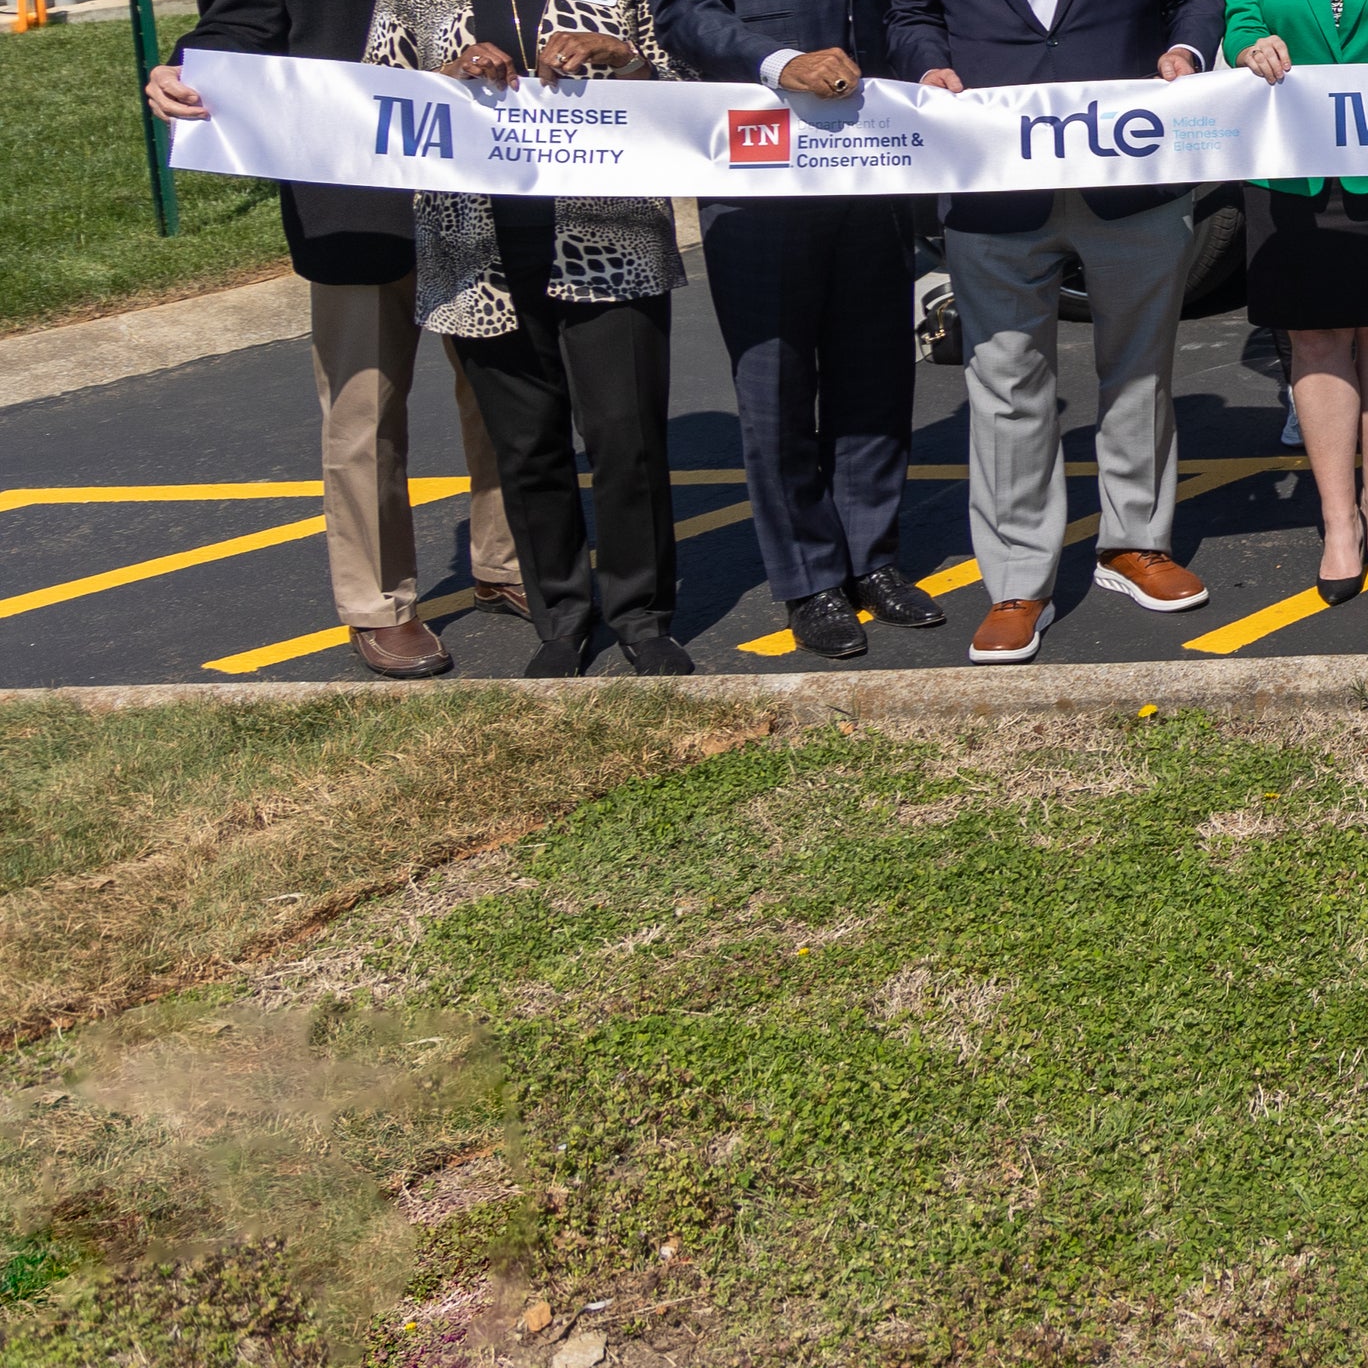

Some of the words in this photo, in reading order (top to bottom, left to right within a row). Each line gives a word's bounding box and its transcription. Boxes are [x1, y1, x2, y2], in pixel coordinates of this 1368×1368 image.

[495, 108, 628, 124] TENNESSEE
[1172, 118, 1216, 127] Middle
[373, 95, 454, 159] TVA
[490, 127, 578, 144] VALLEY
[738, 123, 781, 146] TN
[1020, 100, 1164, 160] mte
[1173, 128, 1240, 139] Tennessee
[798, 134, 908, 149] Environment
[911, 132, 924, 147] &
[1174, 140, 1220, 152] Electric
[488, 146, 624, 164] AUTHORITY
[797, 152, 912, 168] Conservation
